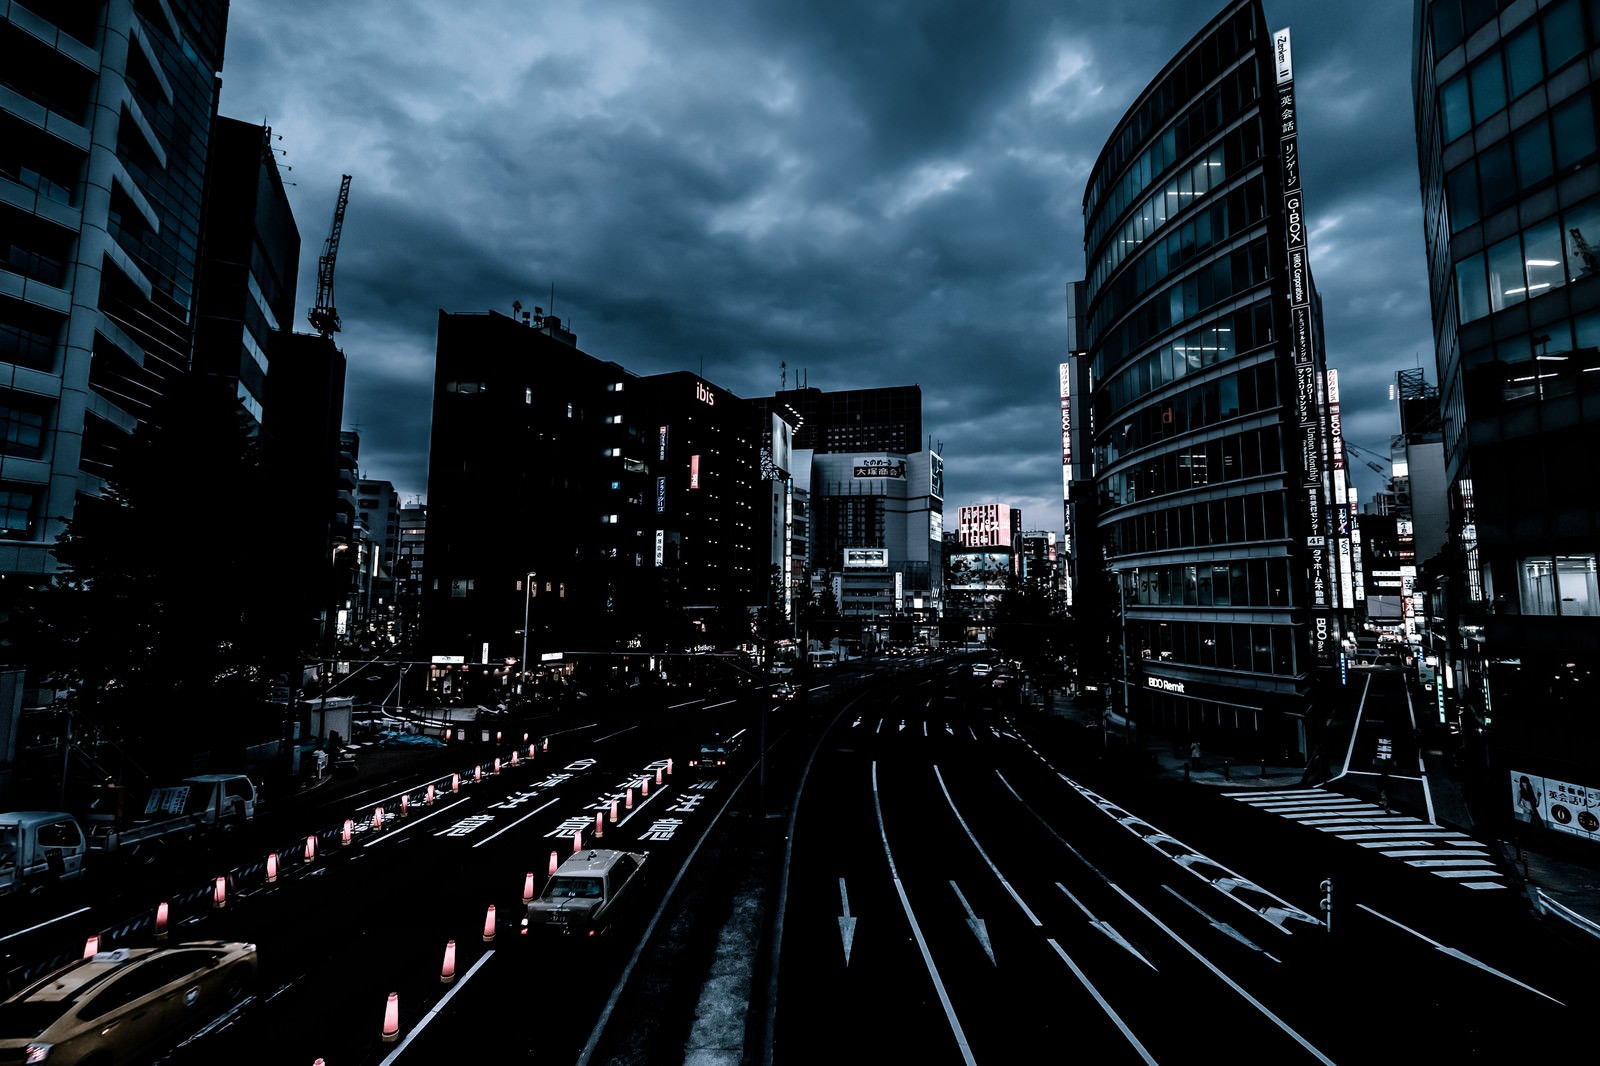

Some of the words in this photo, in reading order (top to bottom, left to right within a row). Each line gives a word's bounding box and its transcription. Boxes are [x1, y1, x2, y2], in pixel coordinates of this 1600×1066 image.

[1280, 95, 1295, 133] 英会話
[1285, 143, 1297, 187] リンゲージ
[1287, 198, 1301, 244] G-BOX
[696, 381, 714, 406] ibis
[1306, 427, 1316, 450] Union
[856, 467, 898, 476] 大塚商会
[863, 459, 893, 467] たのめーる
[1307, 450, 1319, 482] Monthly
[961, 519, 1000, 534] エスパス
[1309, 537, 1323, 545] 4F
[1316, 617, 1327, 640] BDO
[1148, 677, 1163, 689] BDO
[1163, 680, 1185, 693] Remit
